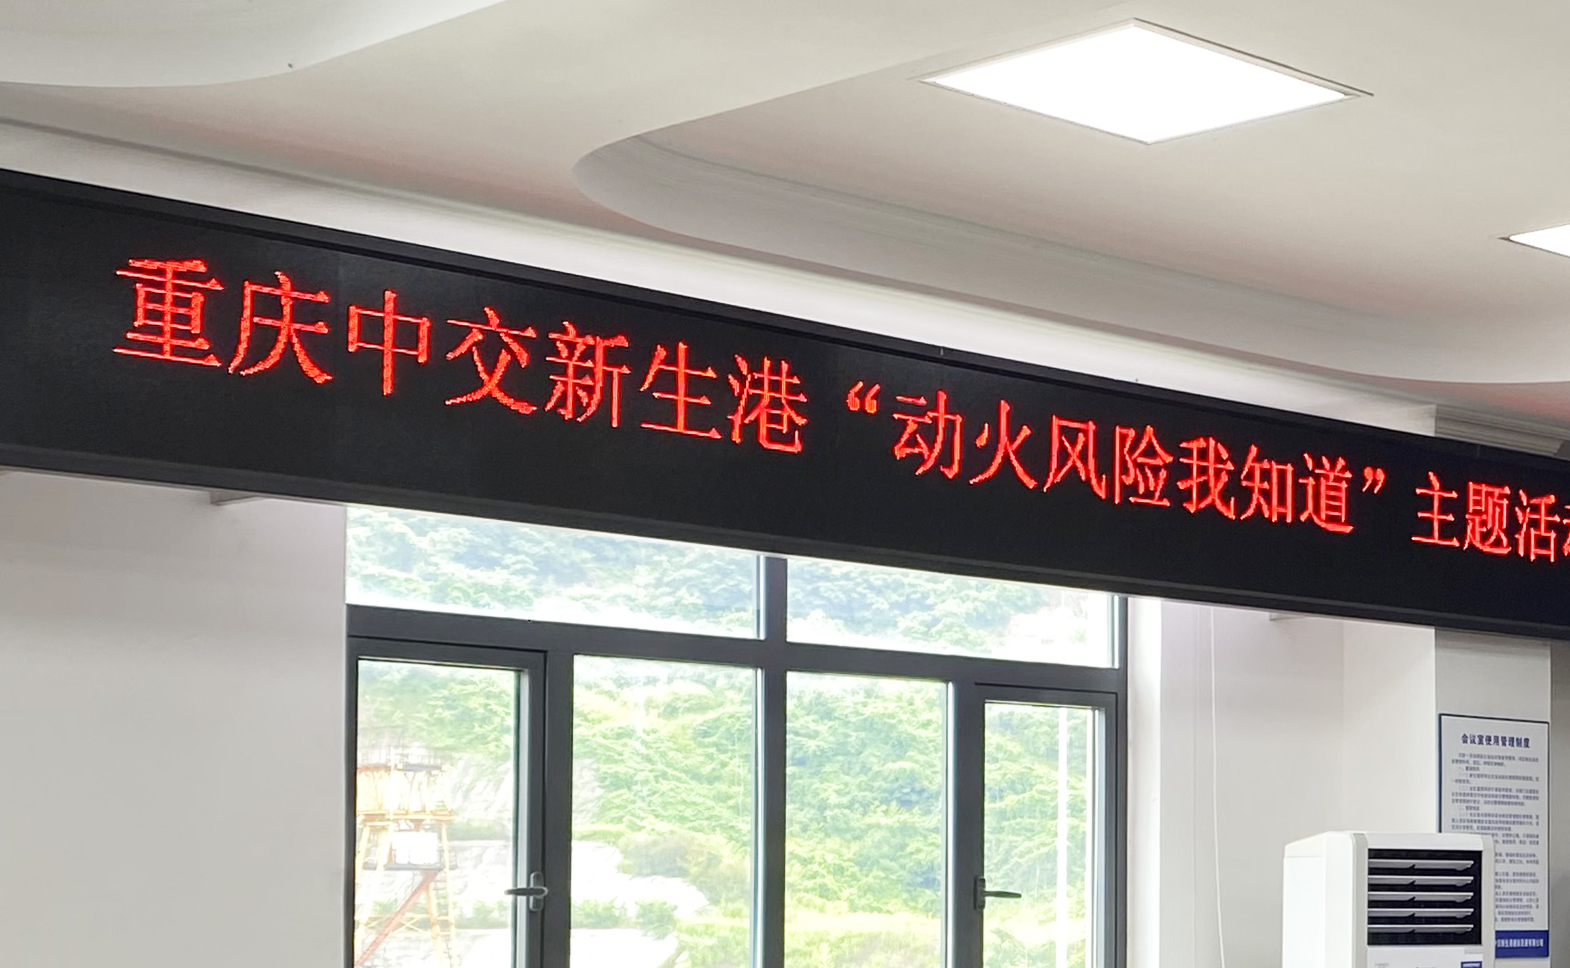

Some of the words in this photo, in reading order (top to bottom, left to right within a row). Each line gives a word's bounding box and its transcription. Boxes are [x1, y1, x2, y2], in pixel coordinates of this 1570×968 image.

[1461, 733, 1530, 749] 会议室使用管理制度
